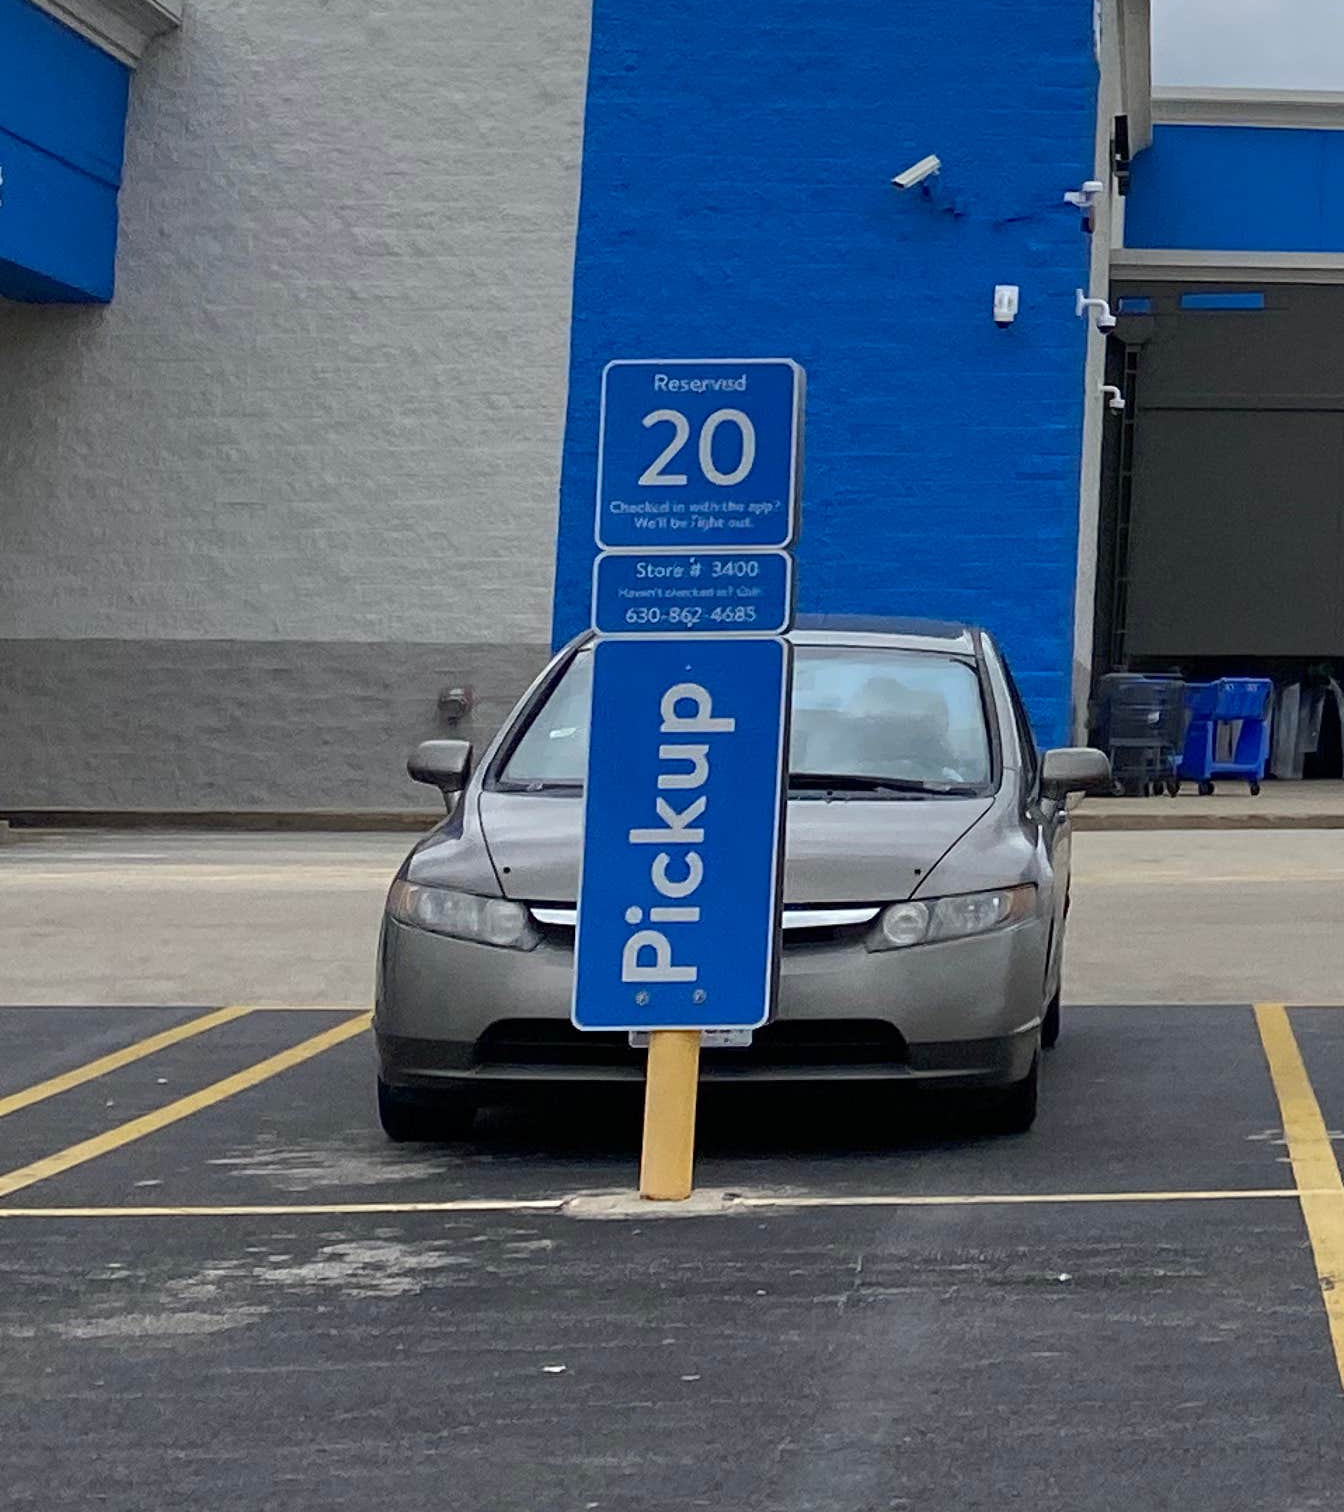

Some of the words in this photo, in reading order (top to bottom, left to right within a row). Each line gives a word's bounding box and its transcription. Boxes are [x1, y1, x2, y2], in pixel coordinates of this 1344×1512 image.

[653, 373, 748, 392] Reserved
[638, 408, 756, 486] 20
[610, 500, 670, 514] Checked
[673, 500, 685, 513] in
[689, 500, 719, 513] with
[723, 500, 745, 513] the
[635, 561, 684, 578] Store
[690, 562, 701, 577] #
[711, 561, 759, 577] 3400
[625, 607, 757, 624] 630-862-4685
[621, 682, 736, 983] Pickup
